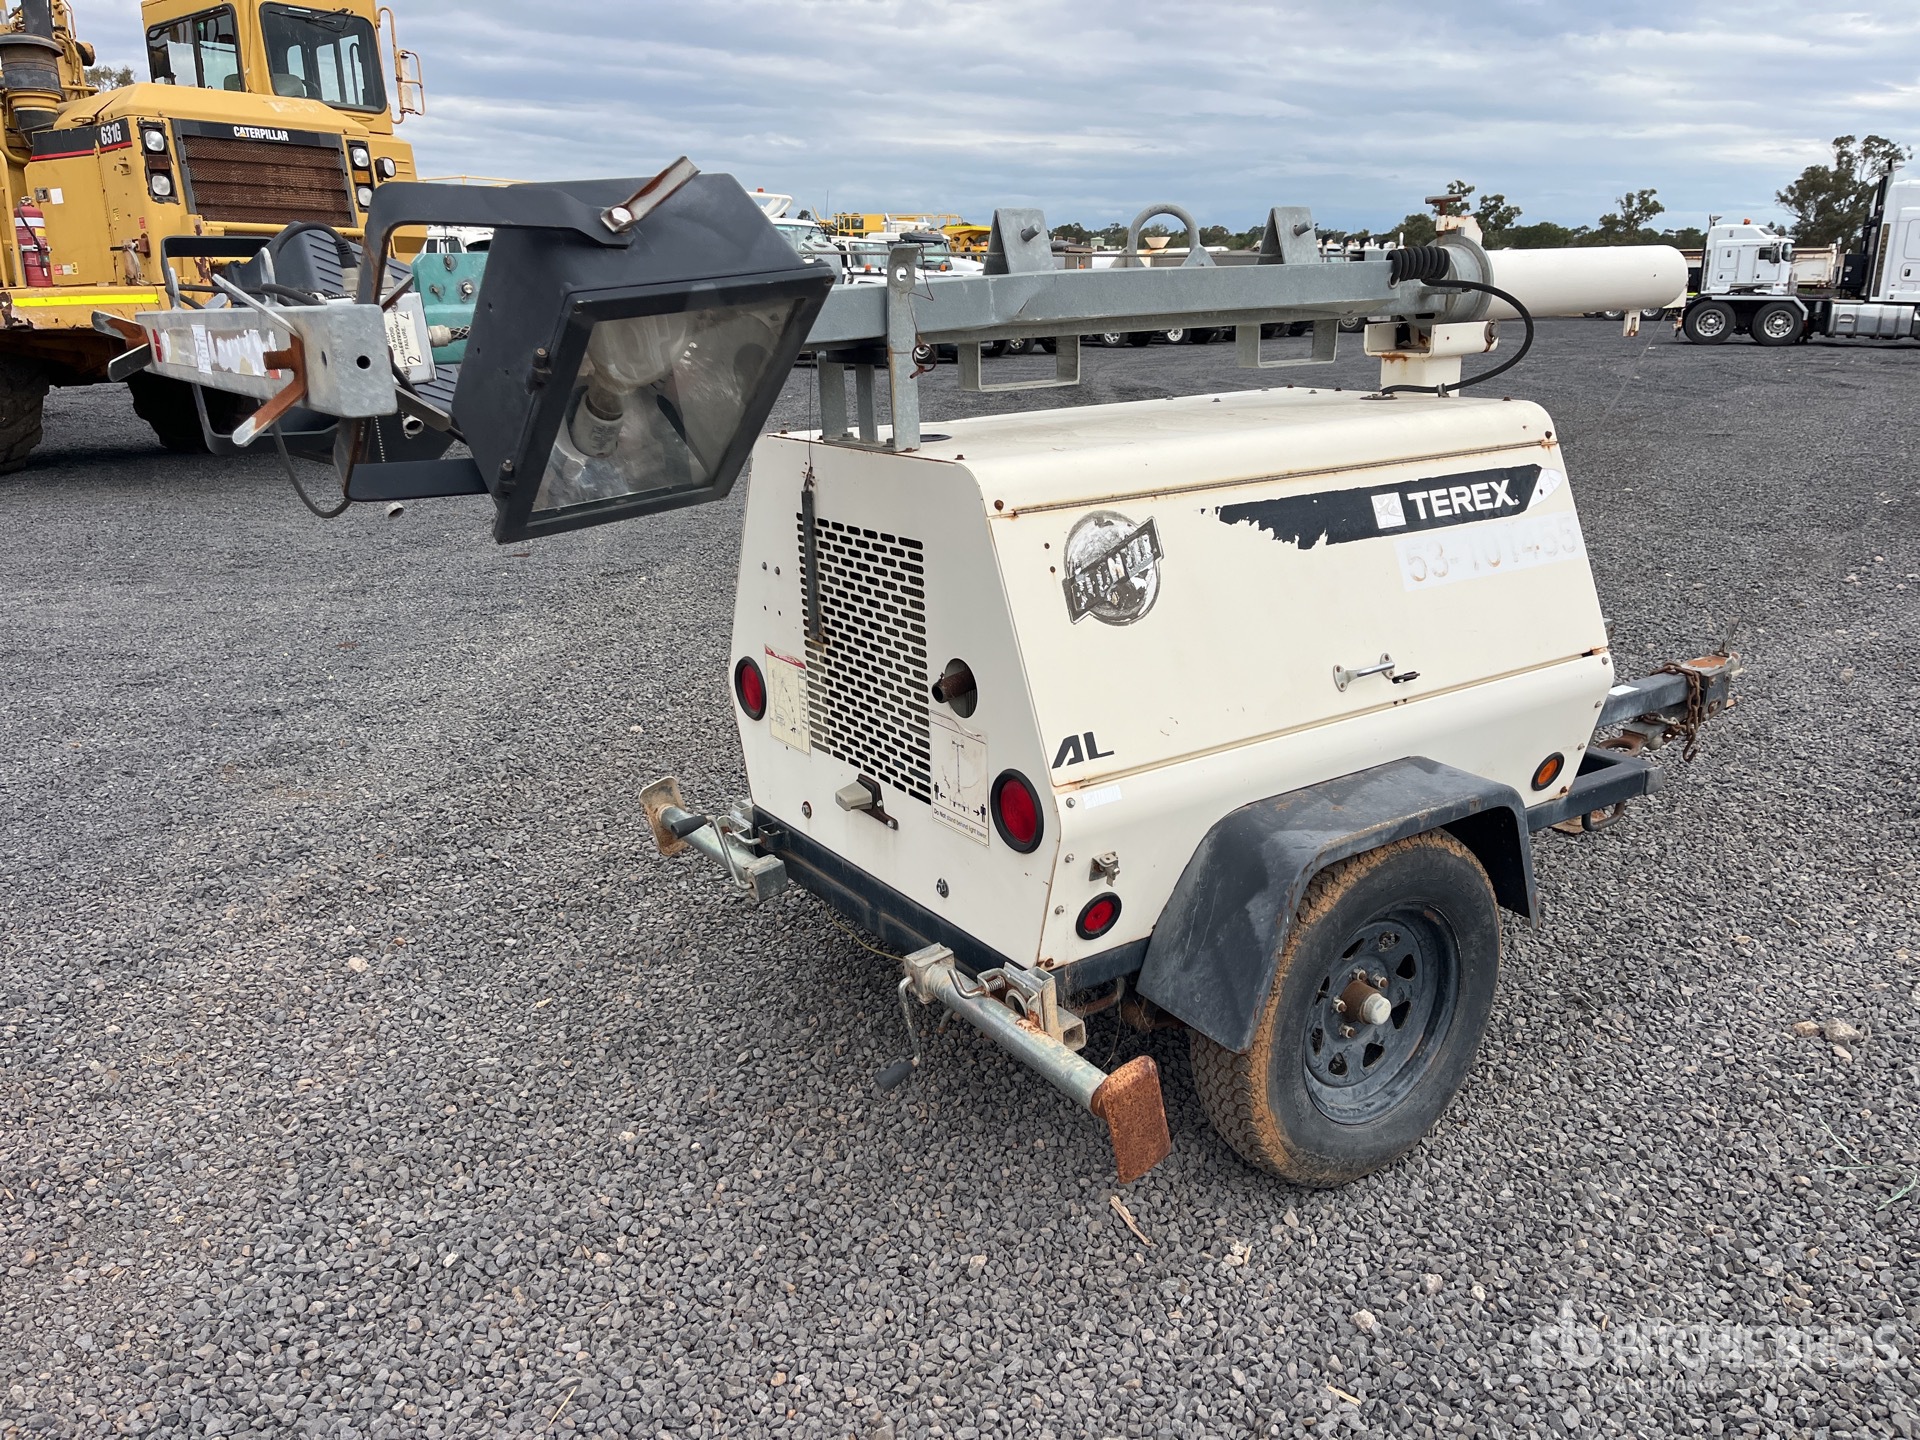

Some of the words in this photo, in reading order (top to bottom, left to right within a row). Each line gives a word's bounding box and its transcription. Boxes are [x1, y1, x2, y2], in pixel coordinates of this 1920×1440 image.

[101, 122, 122, 145] 631G
[233, 126, 289, 141] CATERPILLAR
[1407, 479, 1517, 520] TEREX
[1052, 731, 1115, 768] AL
